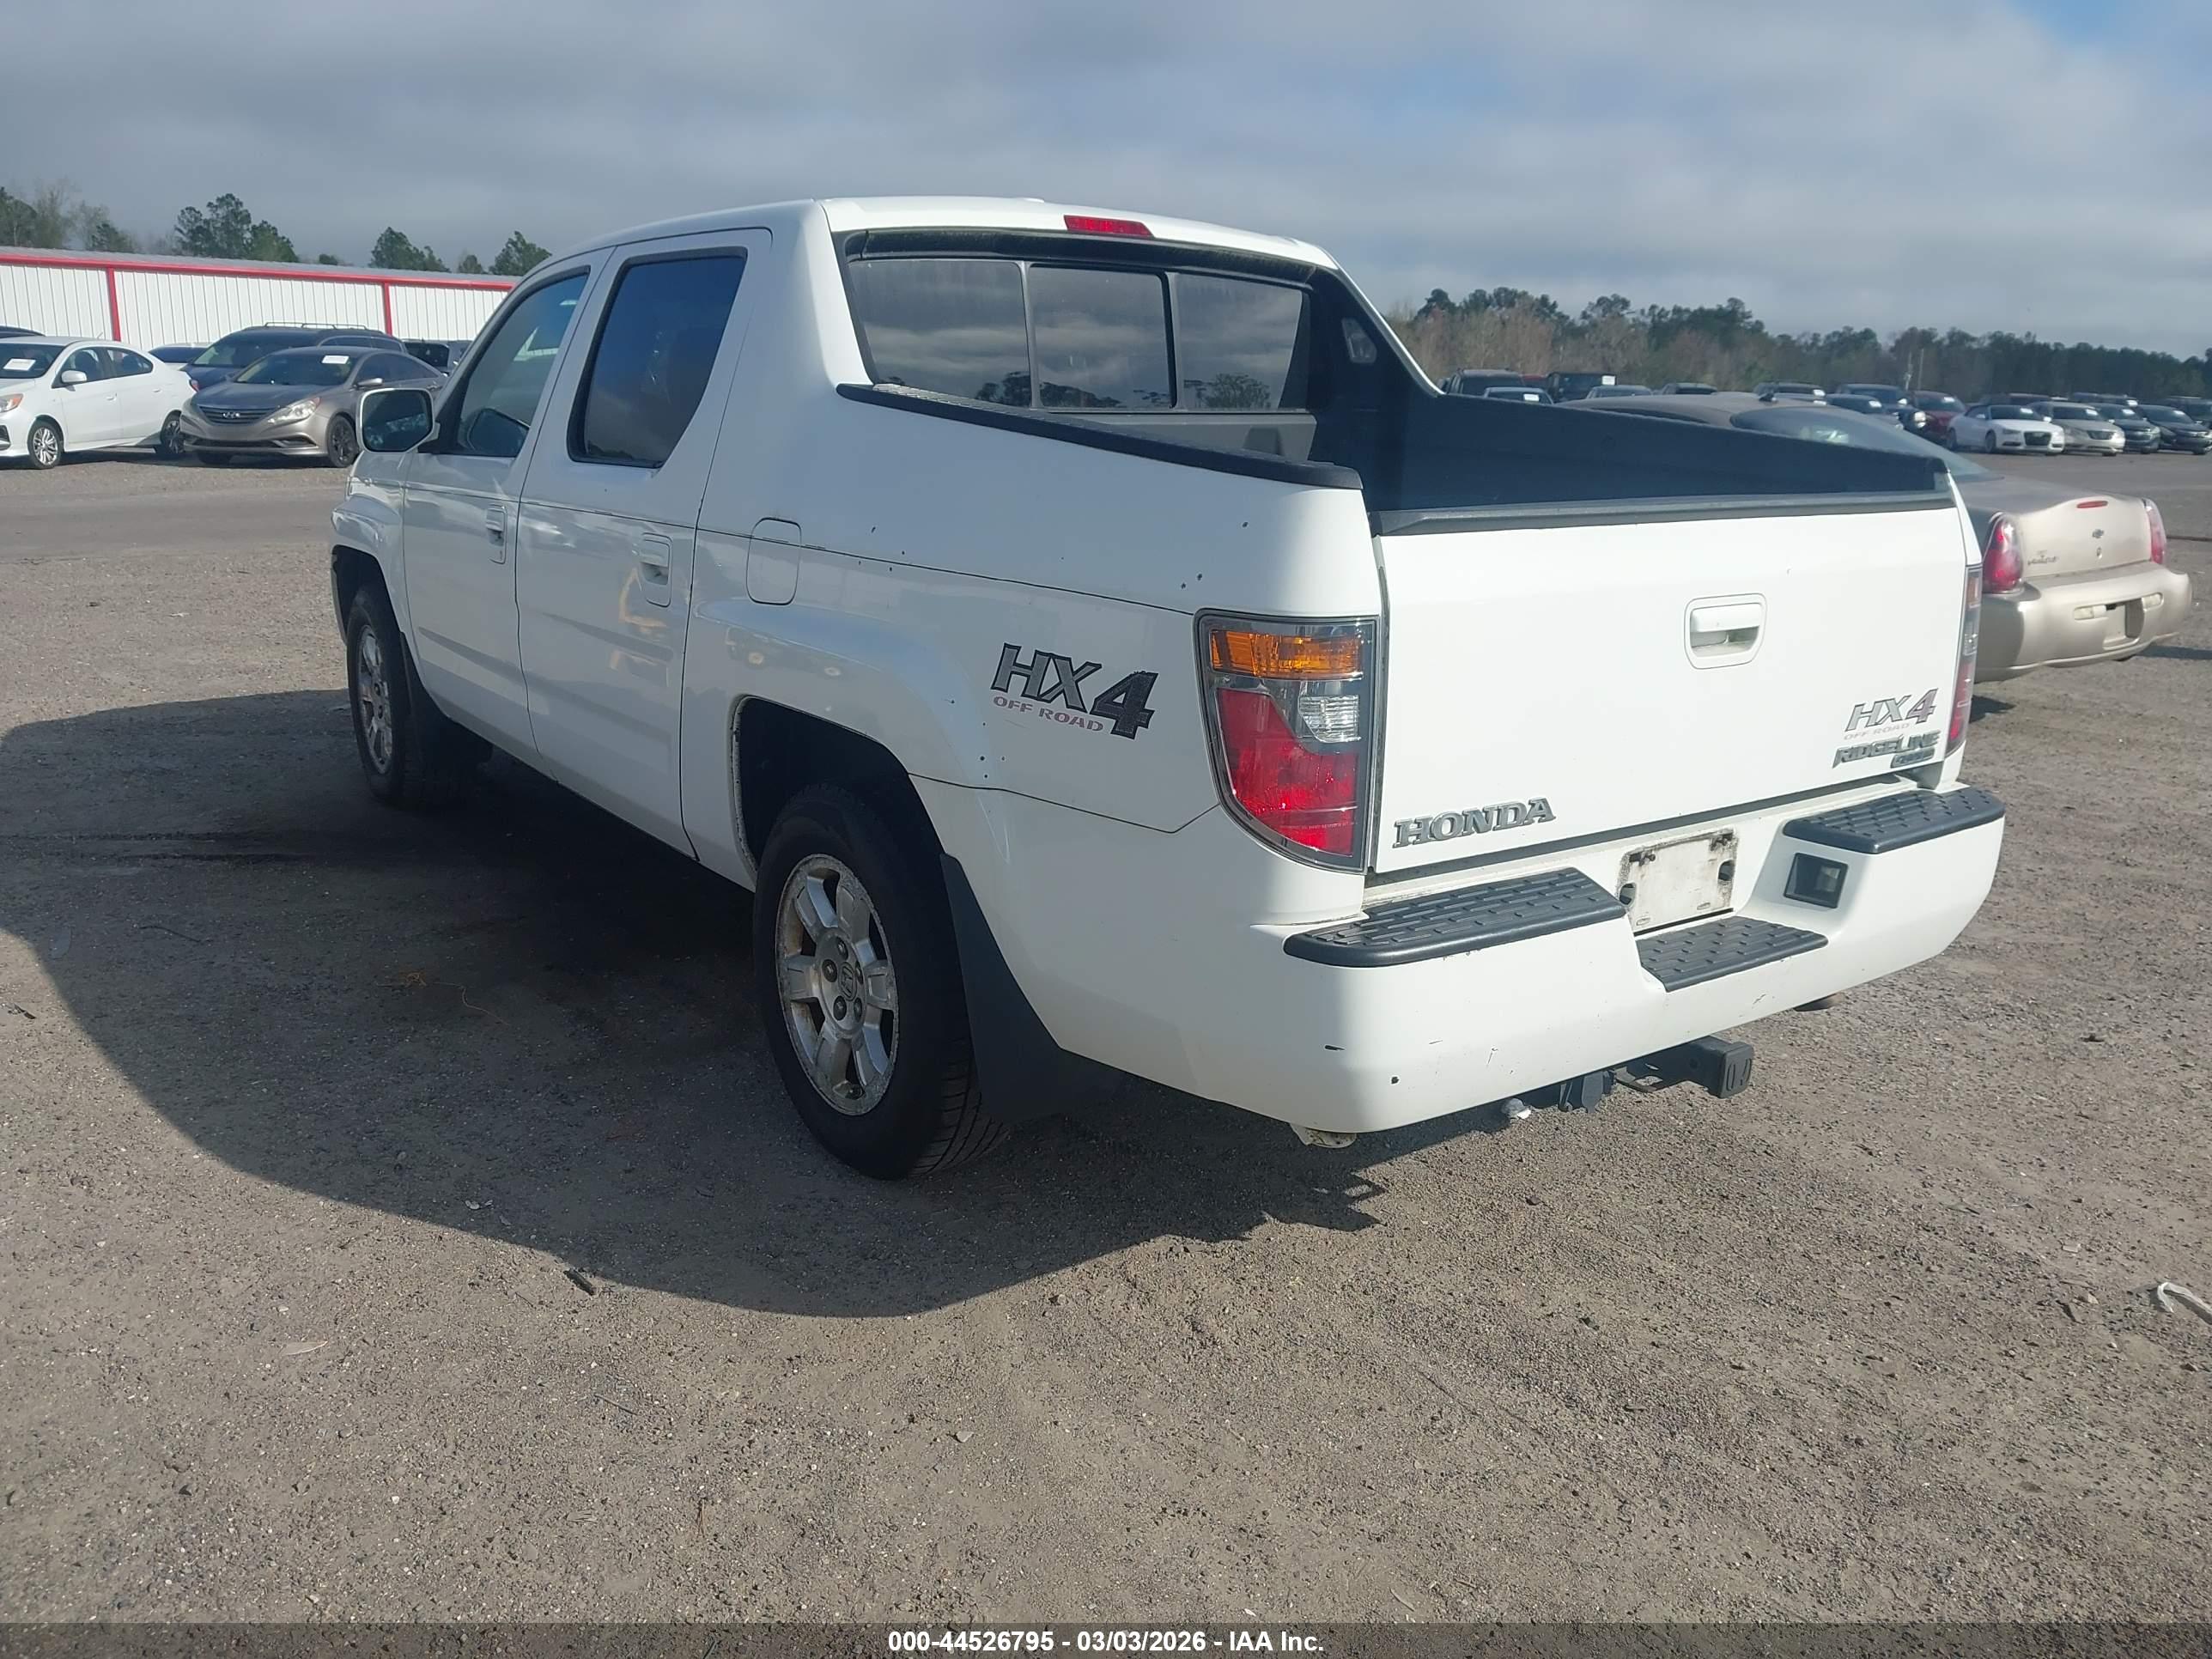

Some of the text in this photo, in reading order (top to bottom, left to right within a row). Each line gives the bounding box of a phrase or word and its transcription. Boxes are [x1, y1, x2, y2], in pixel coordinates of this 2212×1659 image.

[990, 642, 1159, 740] HX4
[1844, 687, 1939, 732] HX4
[993, 696, 1104, 732] OFF ROAD
[1844, 722, 1911, 741] OFF ROAD
[1392, 796, 1557, 849] HONDA
